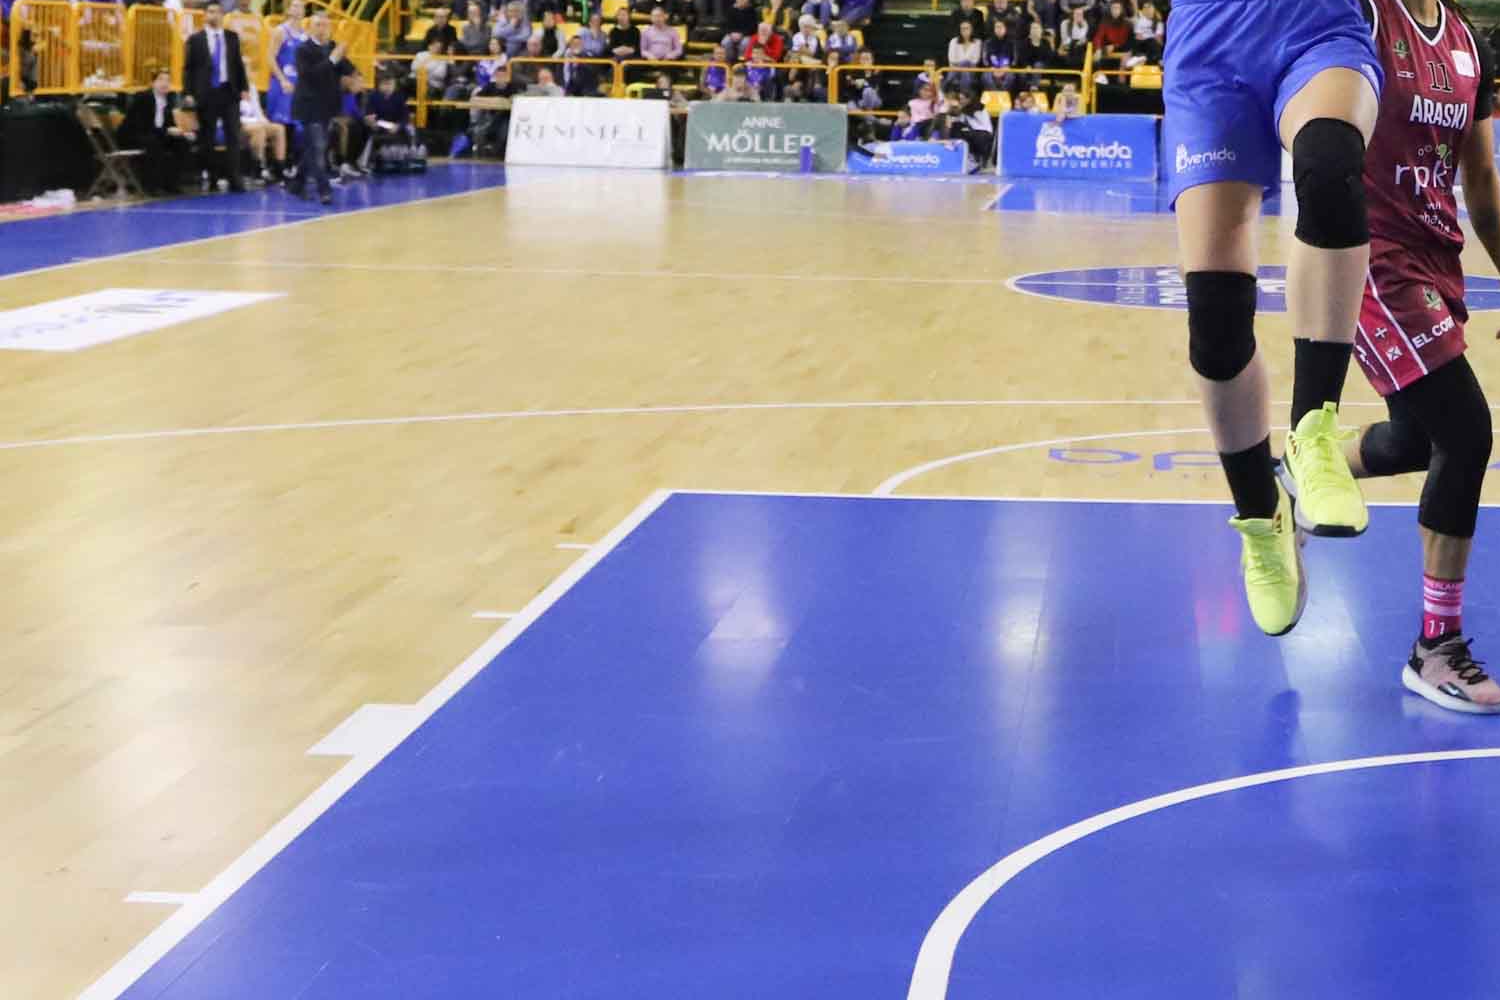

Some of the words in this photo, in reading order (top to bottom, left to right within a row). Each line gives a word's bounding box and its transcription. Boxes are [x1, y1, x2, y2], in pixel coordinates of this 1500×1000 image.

[1428, 61, 1454, 93] 11
[742, 116, 784, 129] ANNE
[1409, 94, 1468, 131] ARASKI
[705, 129, 816, 154] MÖLLER
[1395, 160, 1448, 195] rpk
[1412, 333, 1434, 349] EL
